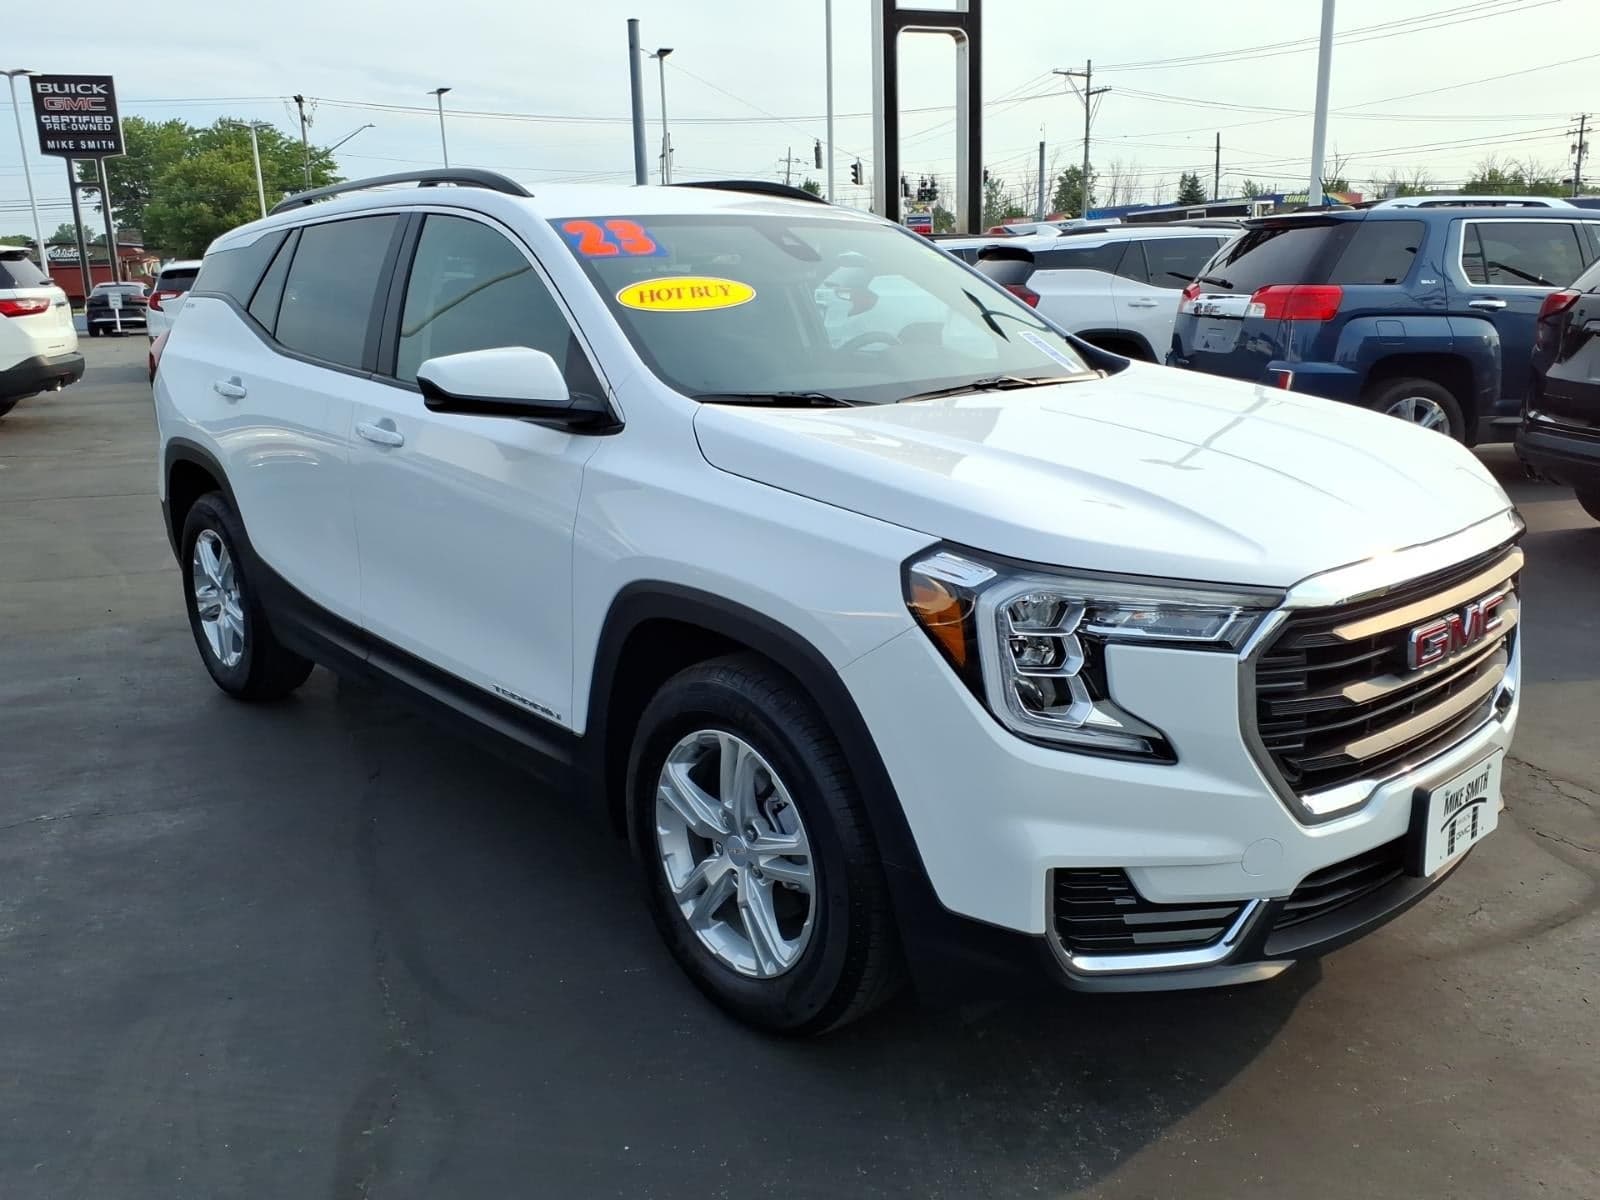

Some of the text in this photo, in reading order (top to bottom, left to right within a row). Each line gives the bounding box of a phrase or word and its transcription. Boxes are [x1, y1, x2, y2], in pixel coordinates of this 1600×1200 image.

[36, 82, 109, 95] BUICK
[43, 96, 107, 111] GMC
[41, 115, 114, 123] CERTIFIED
[46, 123, 111, 131] PRE-OWNED
[47, 140, 115, 149] MIKE SMITH
[638, 284, 732, 304] HOT BUY
[1408, 591, 1504, 670] GMC
[1444, 771, 1489, 817] MIKE SMITH
